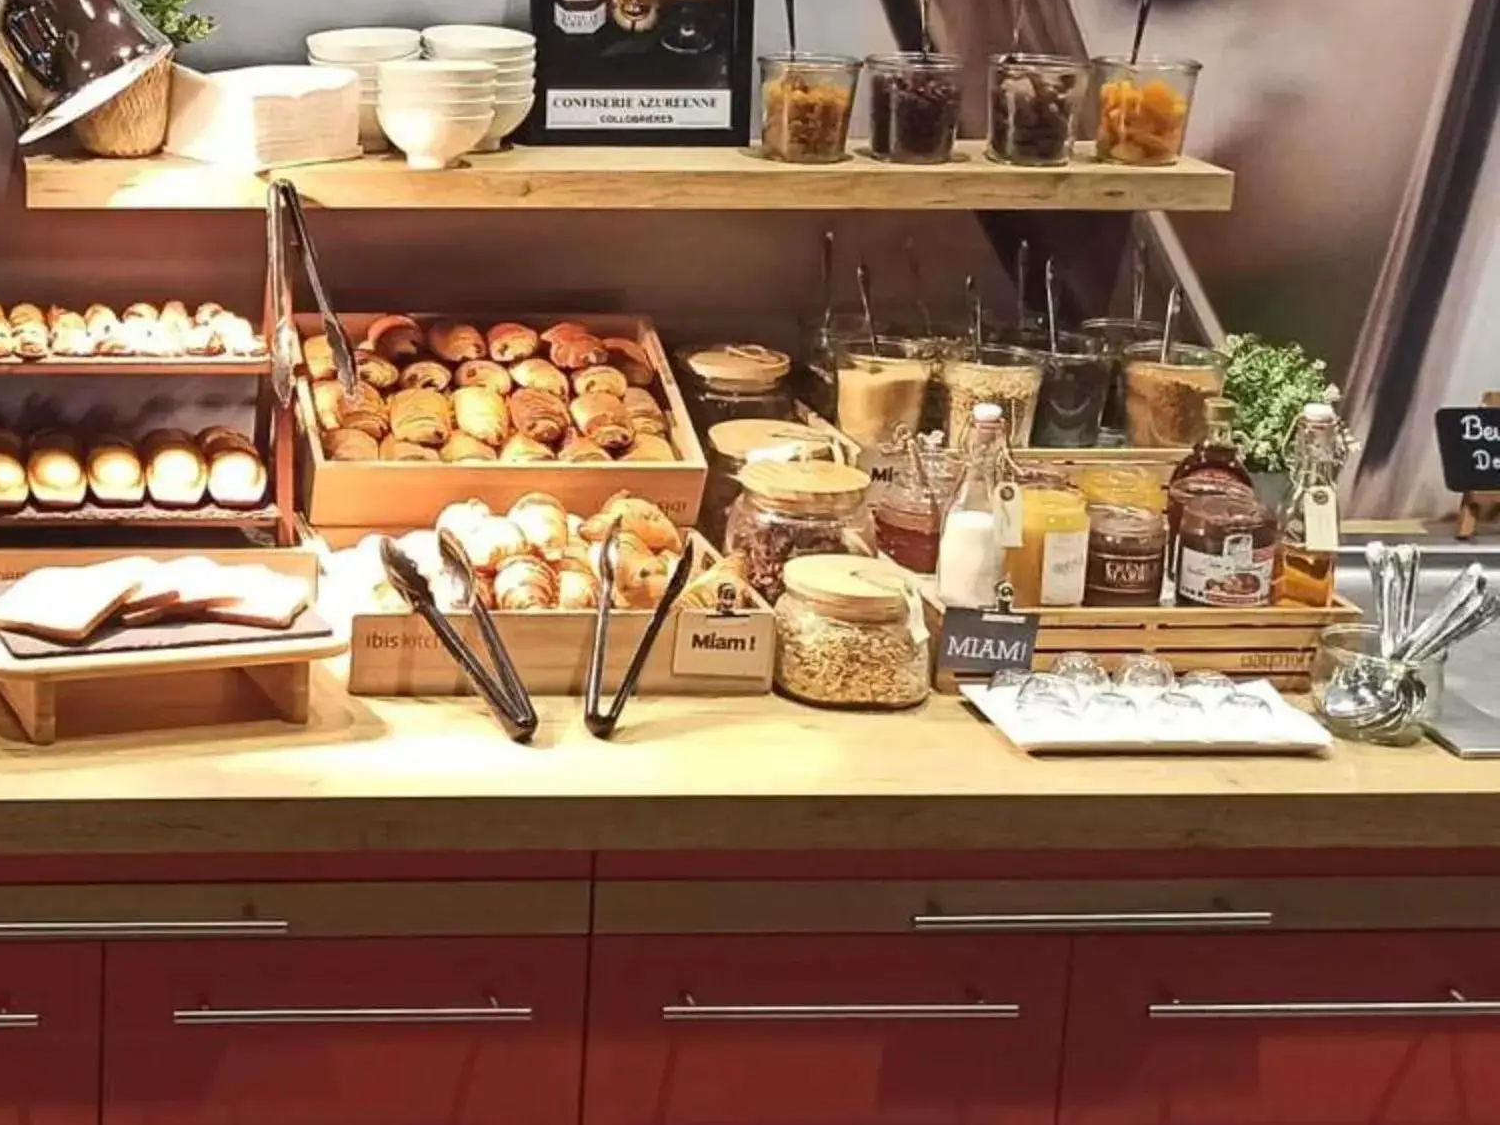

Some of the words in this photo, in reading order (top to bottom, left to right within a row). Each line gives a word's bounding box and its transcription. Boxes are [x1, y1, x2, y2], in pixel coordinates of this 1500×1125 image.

[552, 96, 633, 109] CONFISERIE
[365, 630, 399, 649] ibis
[691, 631, 747, 651] Miam
